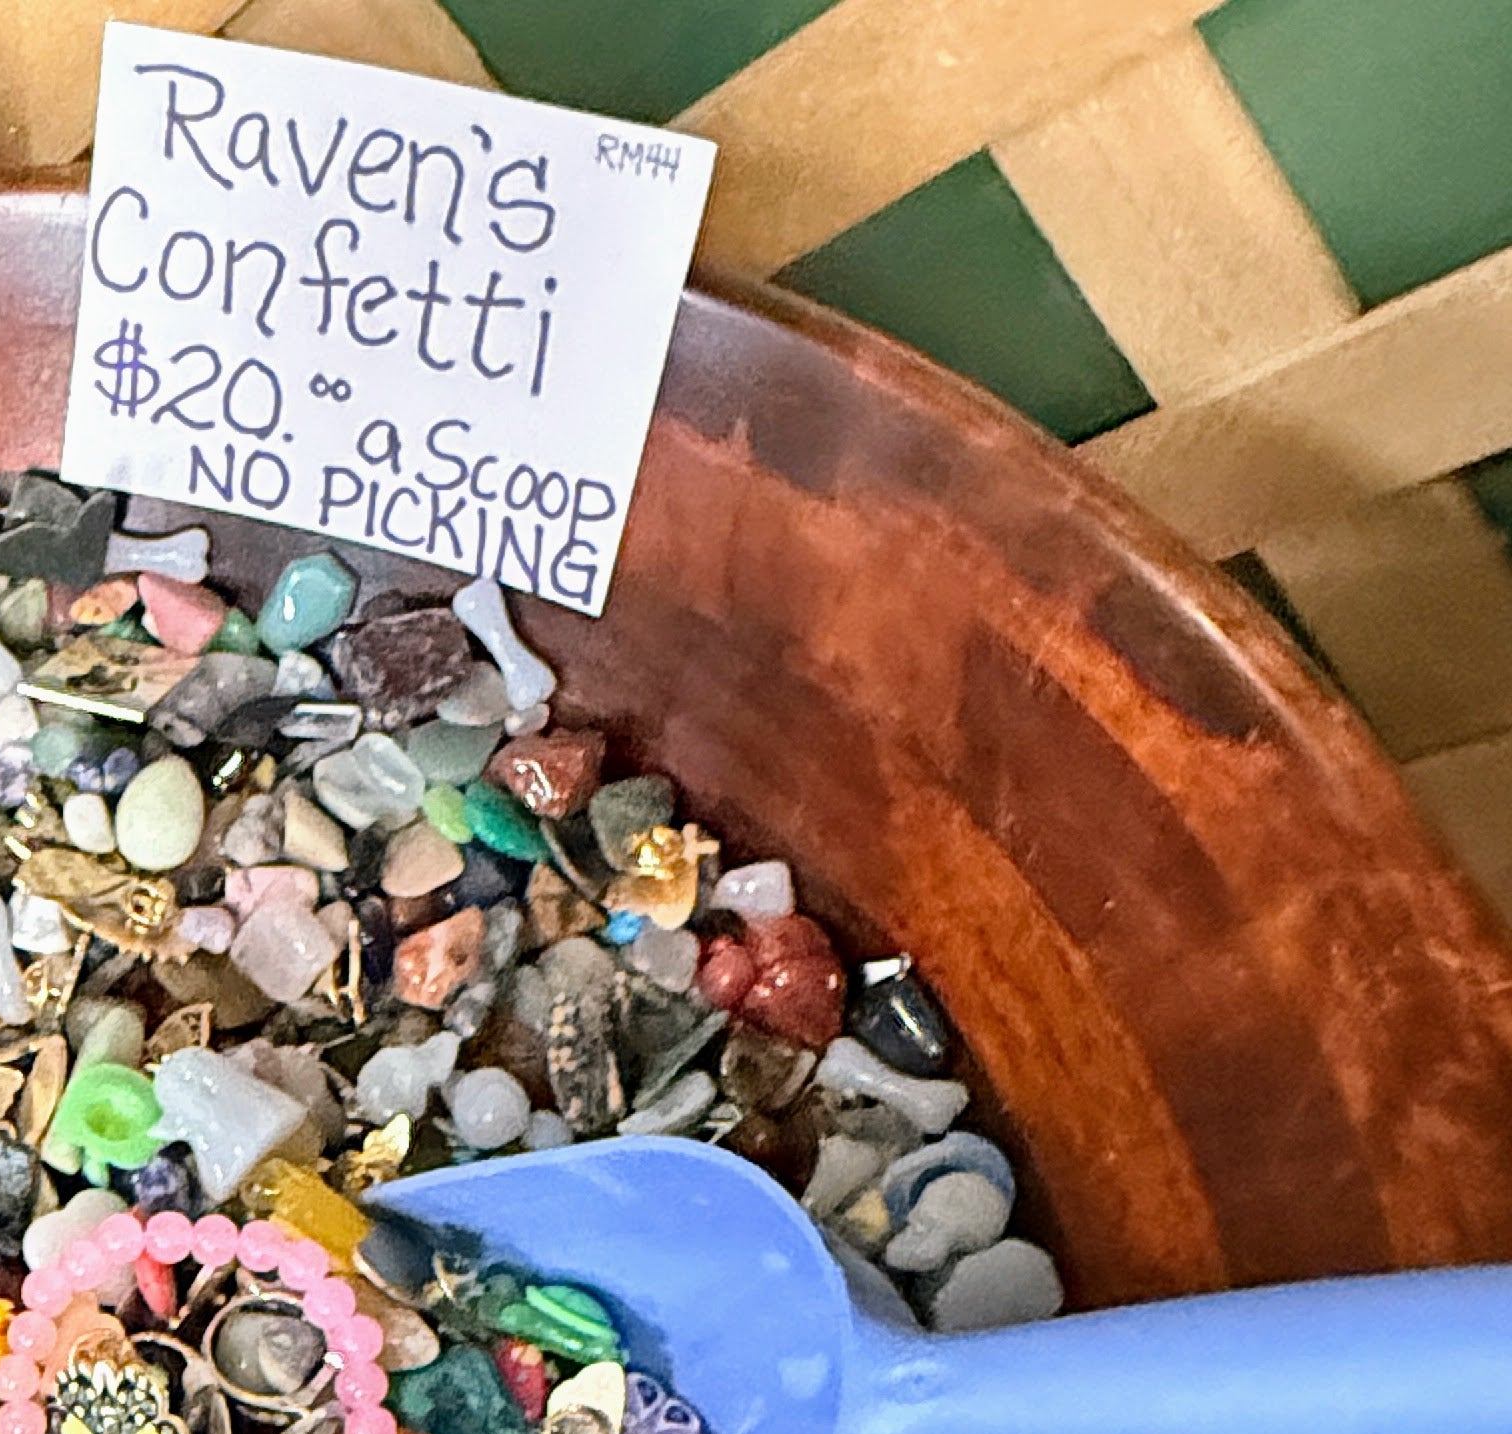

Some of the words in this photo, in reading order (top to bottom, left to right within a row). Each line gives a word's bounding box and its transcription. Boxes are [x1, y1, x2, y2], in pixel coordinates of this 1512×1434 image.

[134, 64, 556, 253] Raven's
[595, 134, 681, 180] RM44
[92, 185, 559, 396] Confetti
[188, 444, 290, 510] NO
[319, 465, 598, 605] PICKING
[357, 419, 401, 473] a
